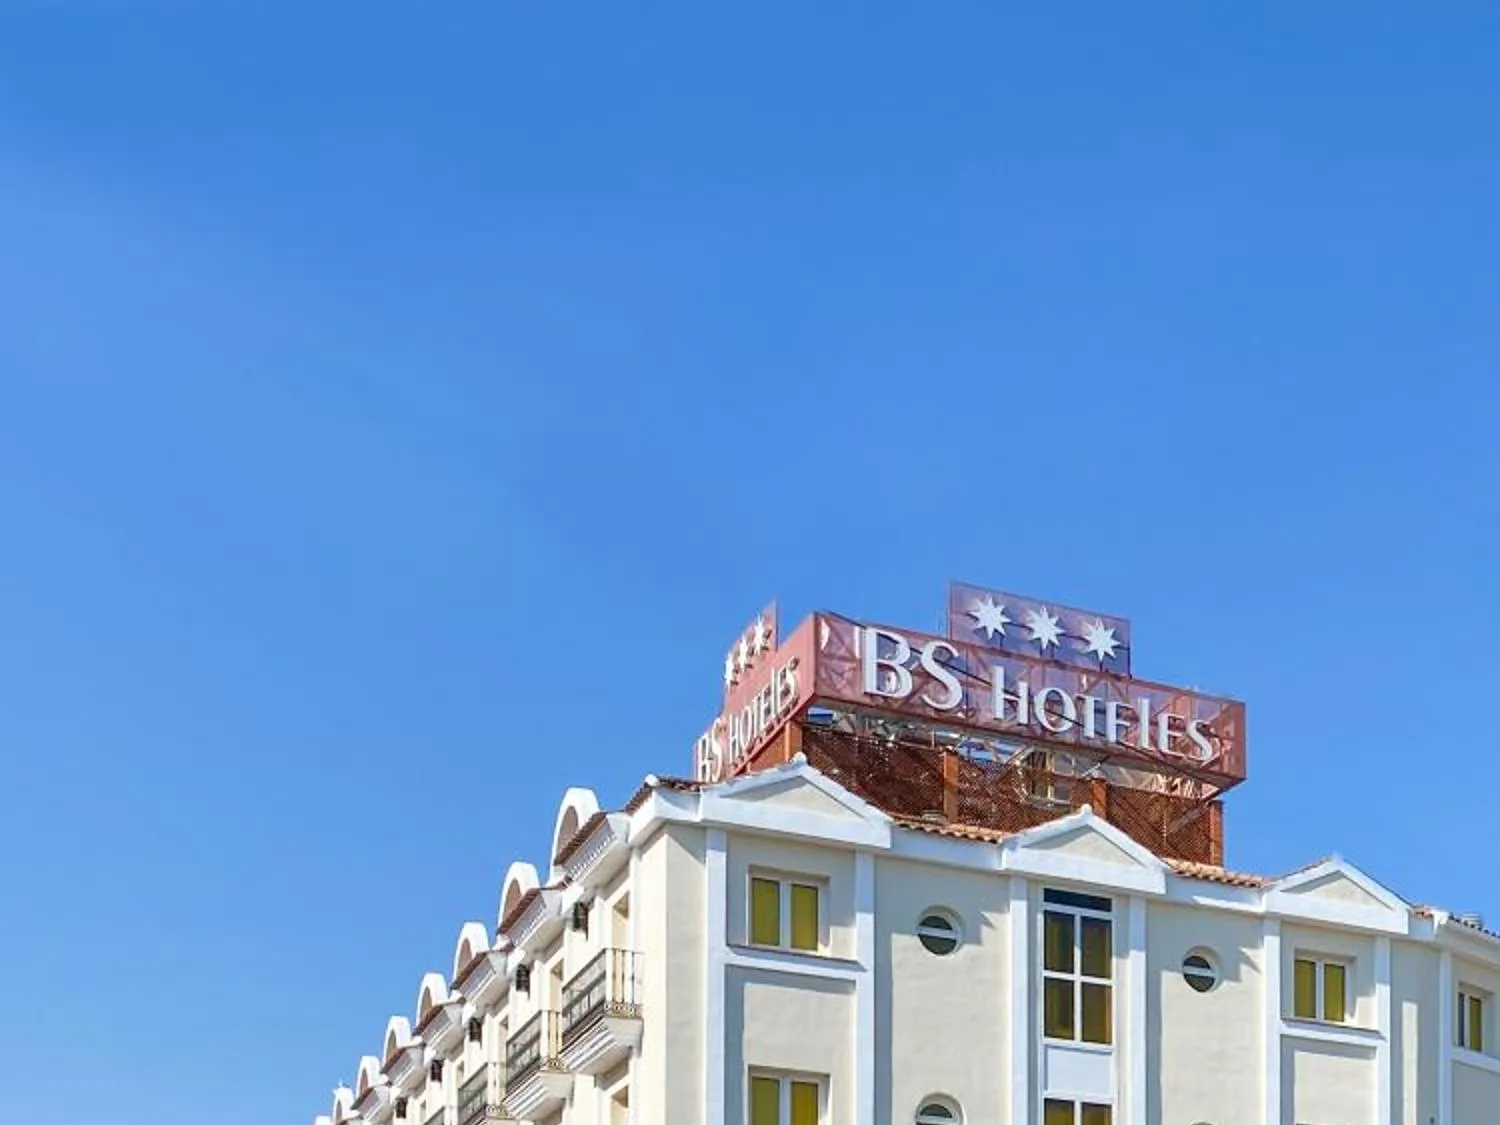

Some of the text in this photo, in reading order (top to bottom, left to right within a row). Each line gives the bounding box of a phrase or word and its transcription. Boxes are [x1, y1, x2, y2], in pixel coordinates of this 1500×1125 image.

[866, 626, 1213, 762] BS HOTELES
[697, 716, 723, 784] BS
